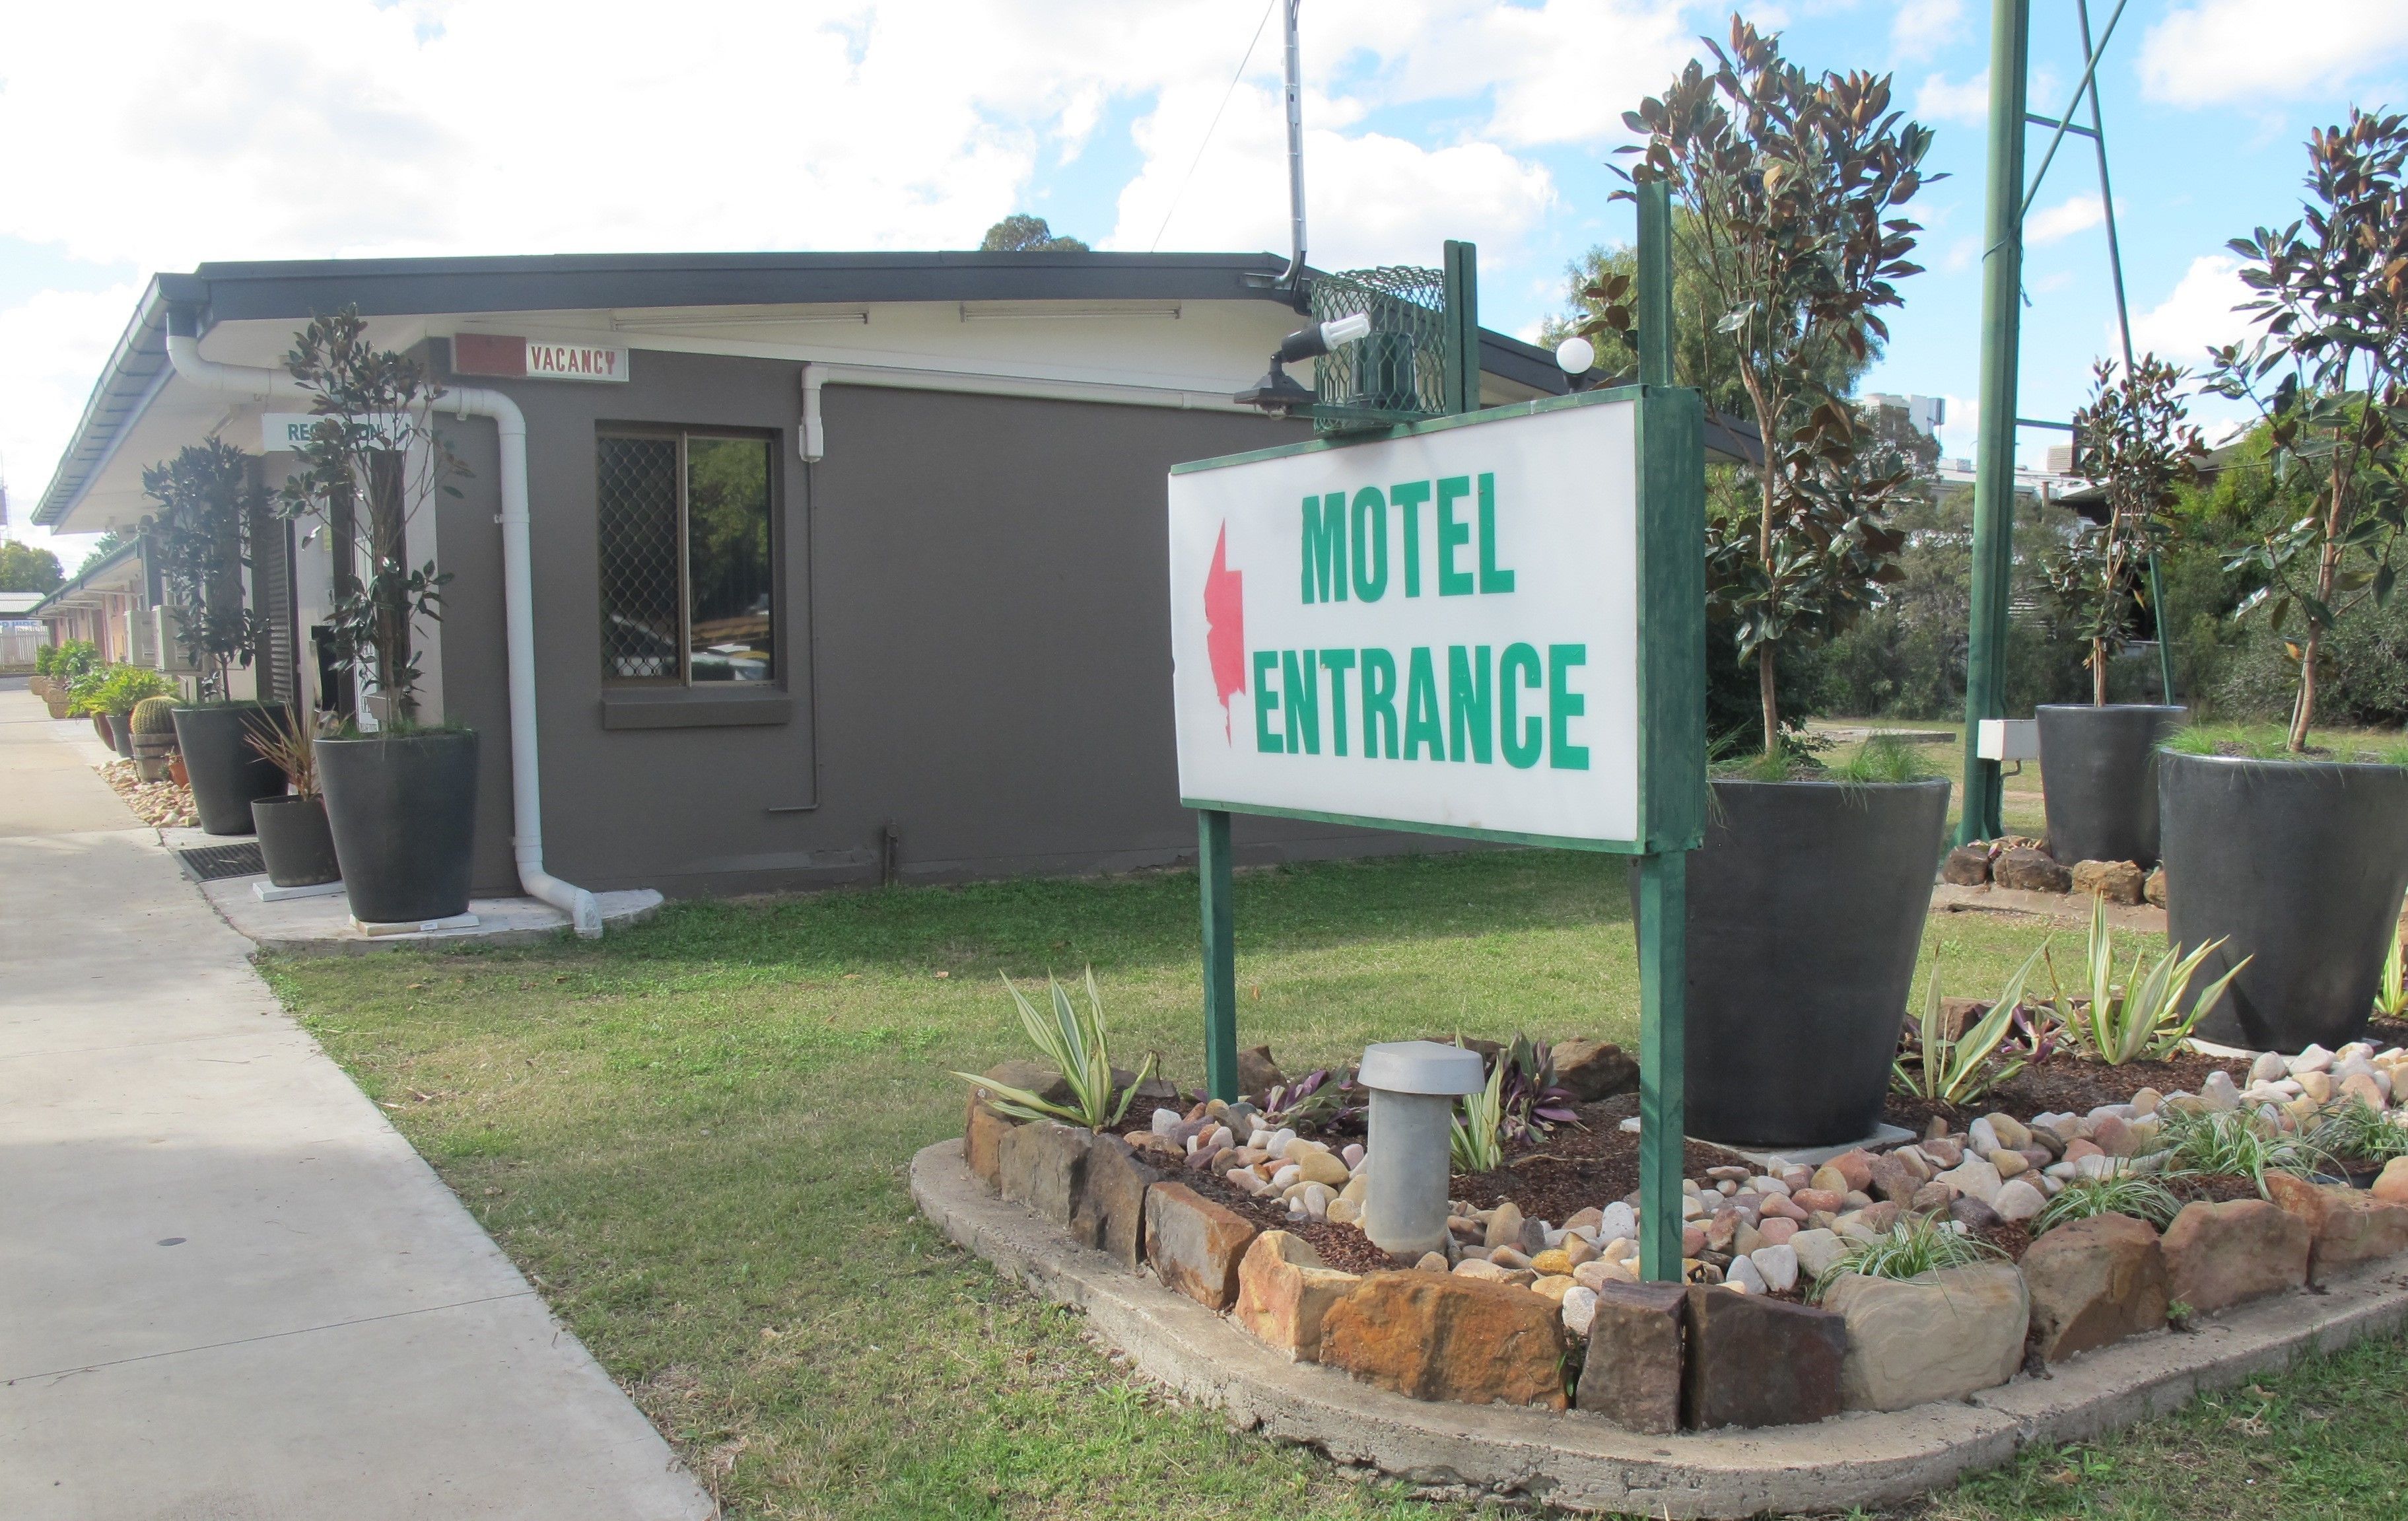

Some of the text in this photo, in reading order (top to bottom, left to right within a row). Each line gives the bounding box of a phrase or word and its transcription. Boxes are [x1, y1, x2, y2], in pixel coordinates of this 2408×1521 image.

[531, 346, 615, 375] VACANCY
[1301, 472, 1515, 604] MOTEL
[1253, 643, 1590, 770] ENTRANCE
